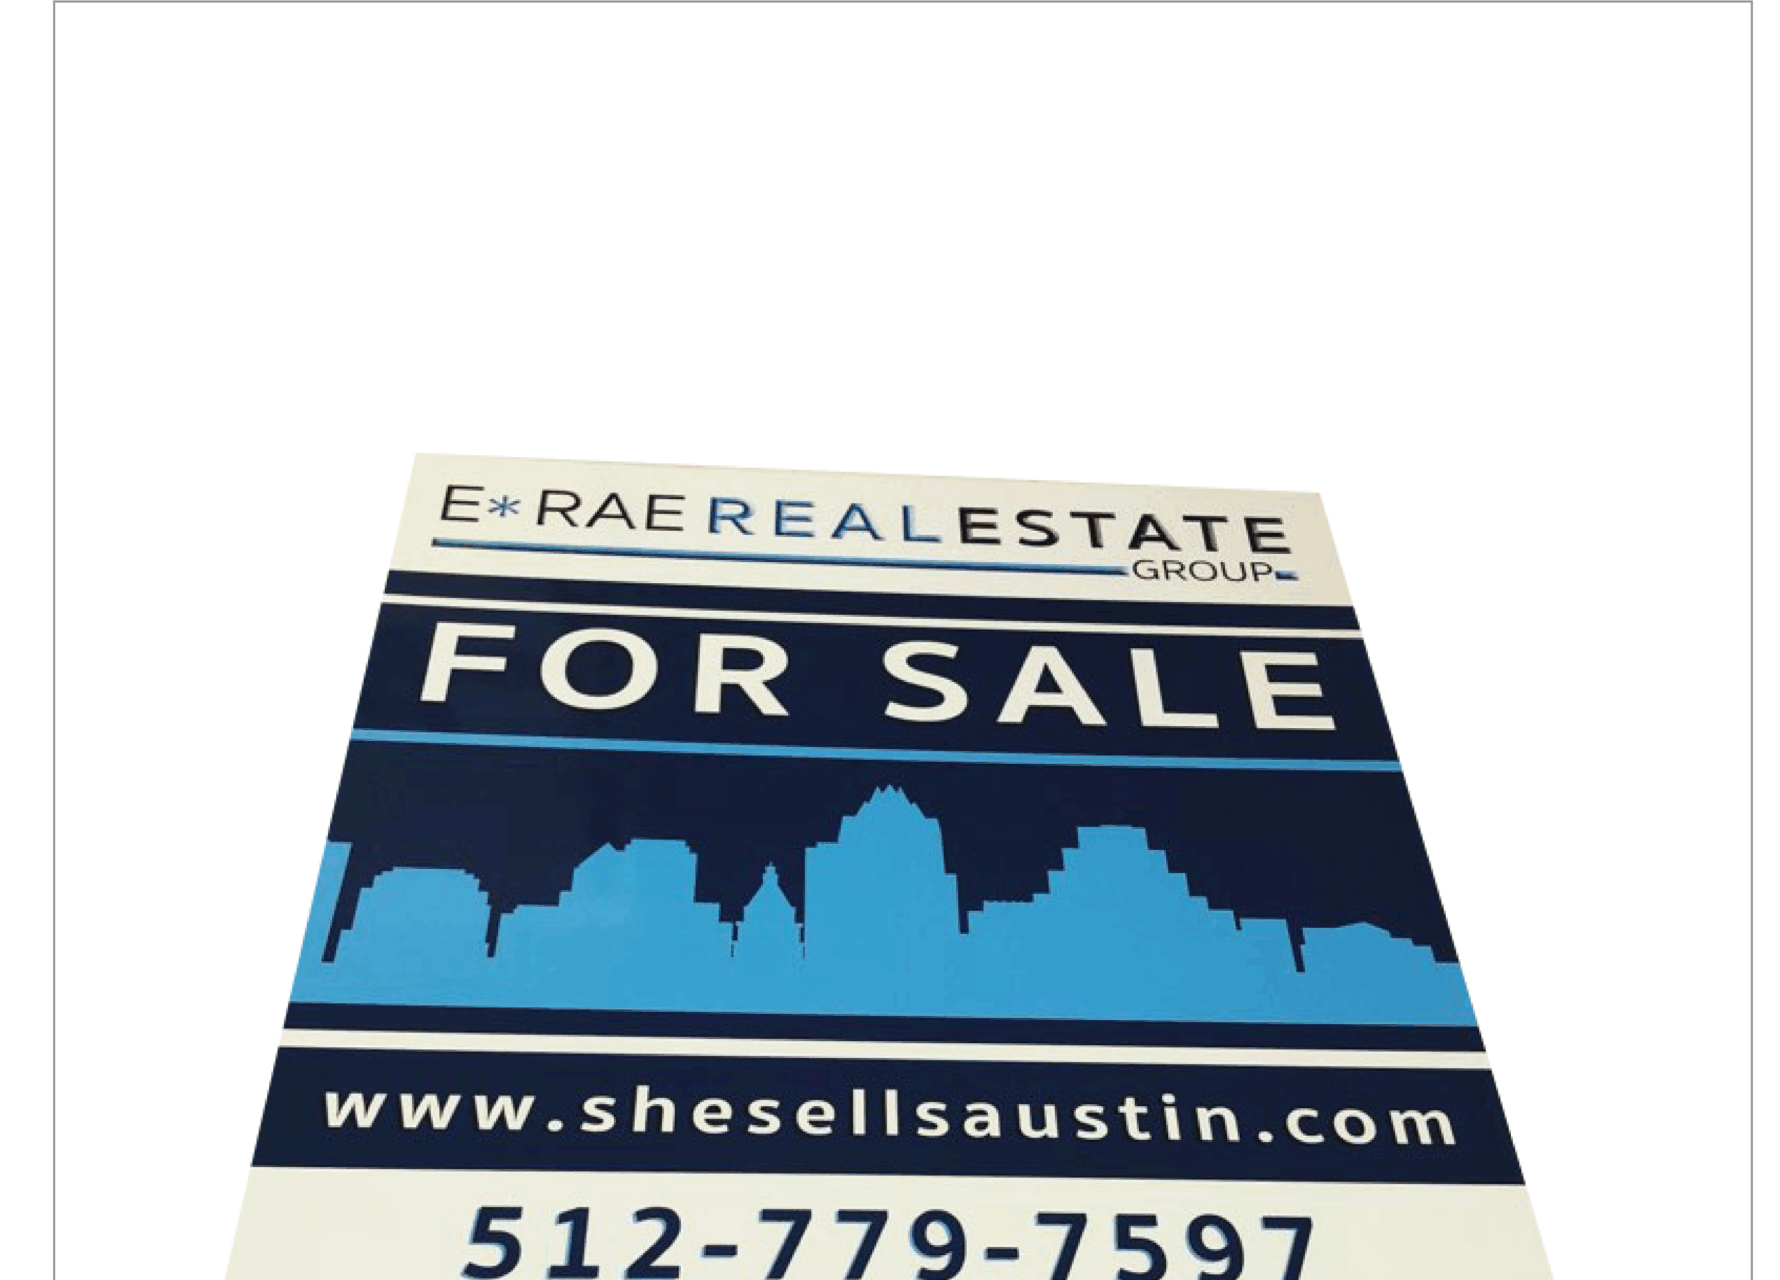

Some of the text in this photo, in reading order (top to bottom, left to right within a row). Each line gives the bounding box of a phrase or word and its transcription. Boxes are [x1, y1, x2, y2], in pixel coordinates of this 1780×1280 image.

[1132, 559, 1274, 583] GROUP
[419, 622, 1337, 731] FOR SALE
[323, 1085, 1457, 1147] www.shesellsaustin.com
